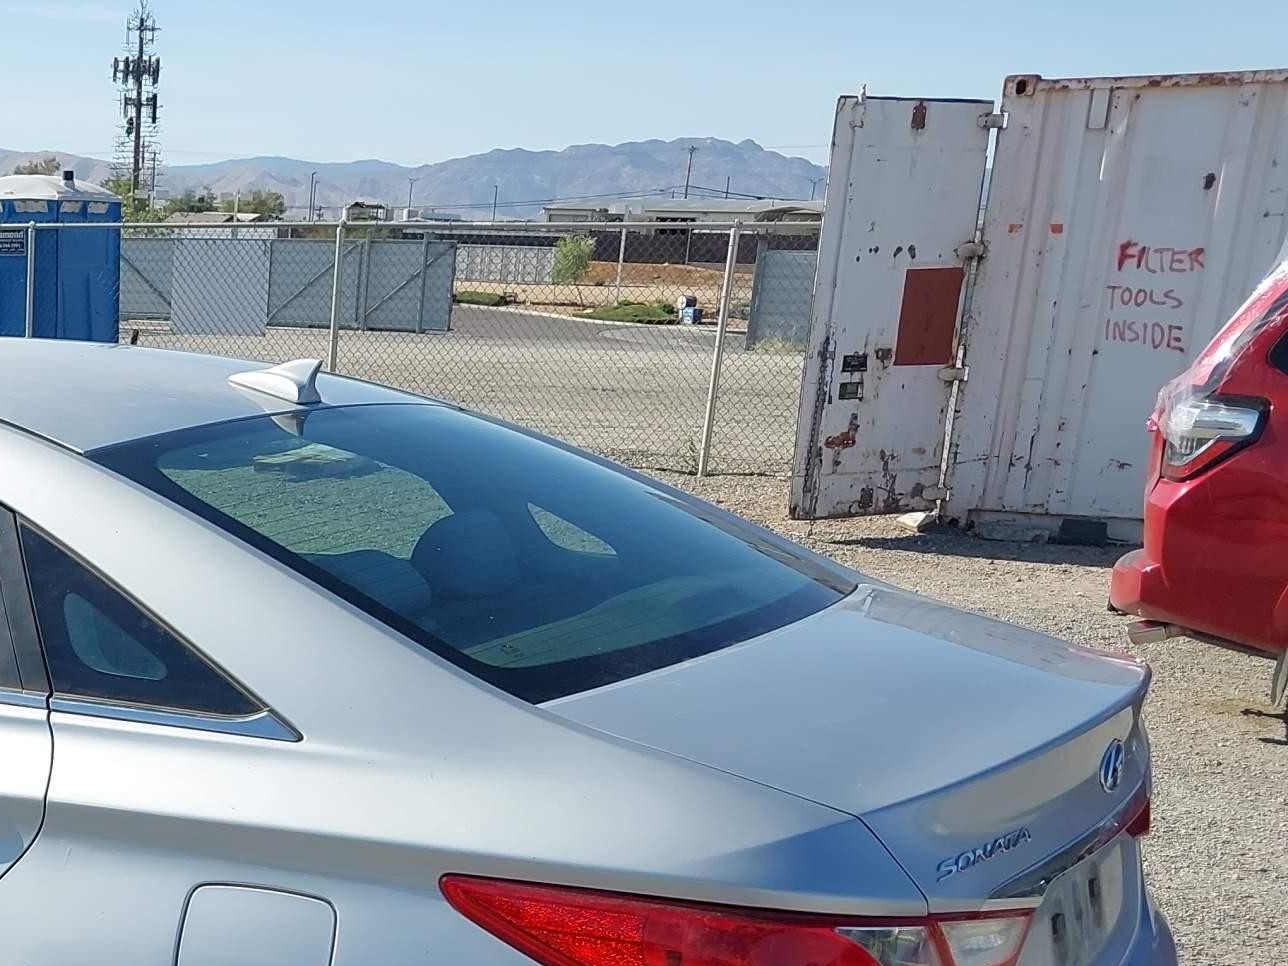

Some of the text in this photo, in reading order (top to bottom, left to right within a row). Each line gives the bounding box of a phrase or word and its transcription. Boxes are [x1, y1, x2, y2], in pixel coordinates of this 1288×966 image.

[1117, 240, 1205, 274] FILTER
[1106, 285, 1184, 311] TOOLS
[1105, 318, 1185, 353] INSIDE
[936, 826, 1032, 883] SONATA
